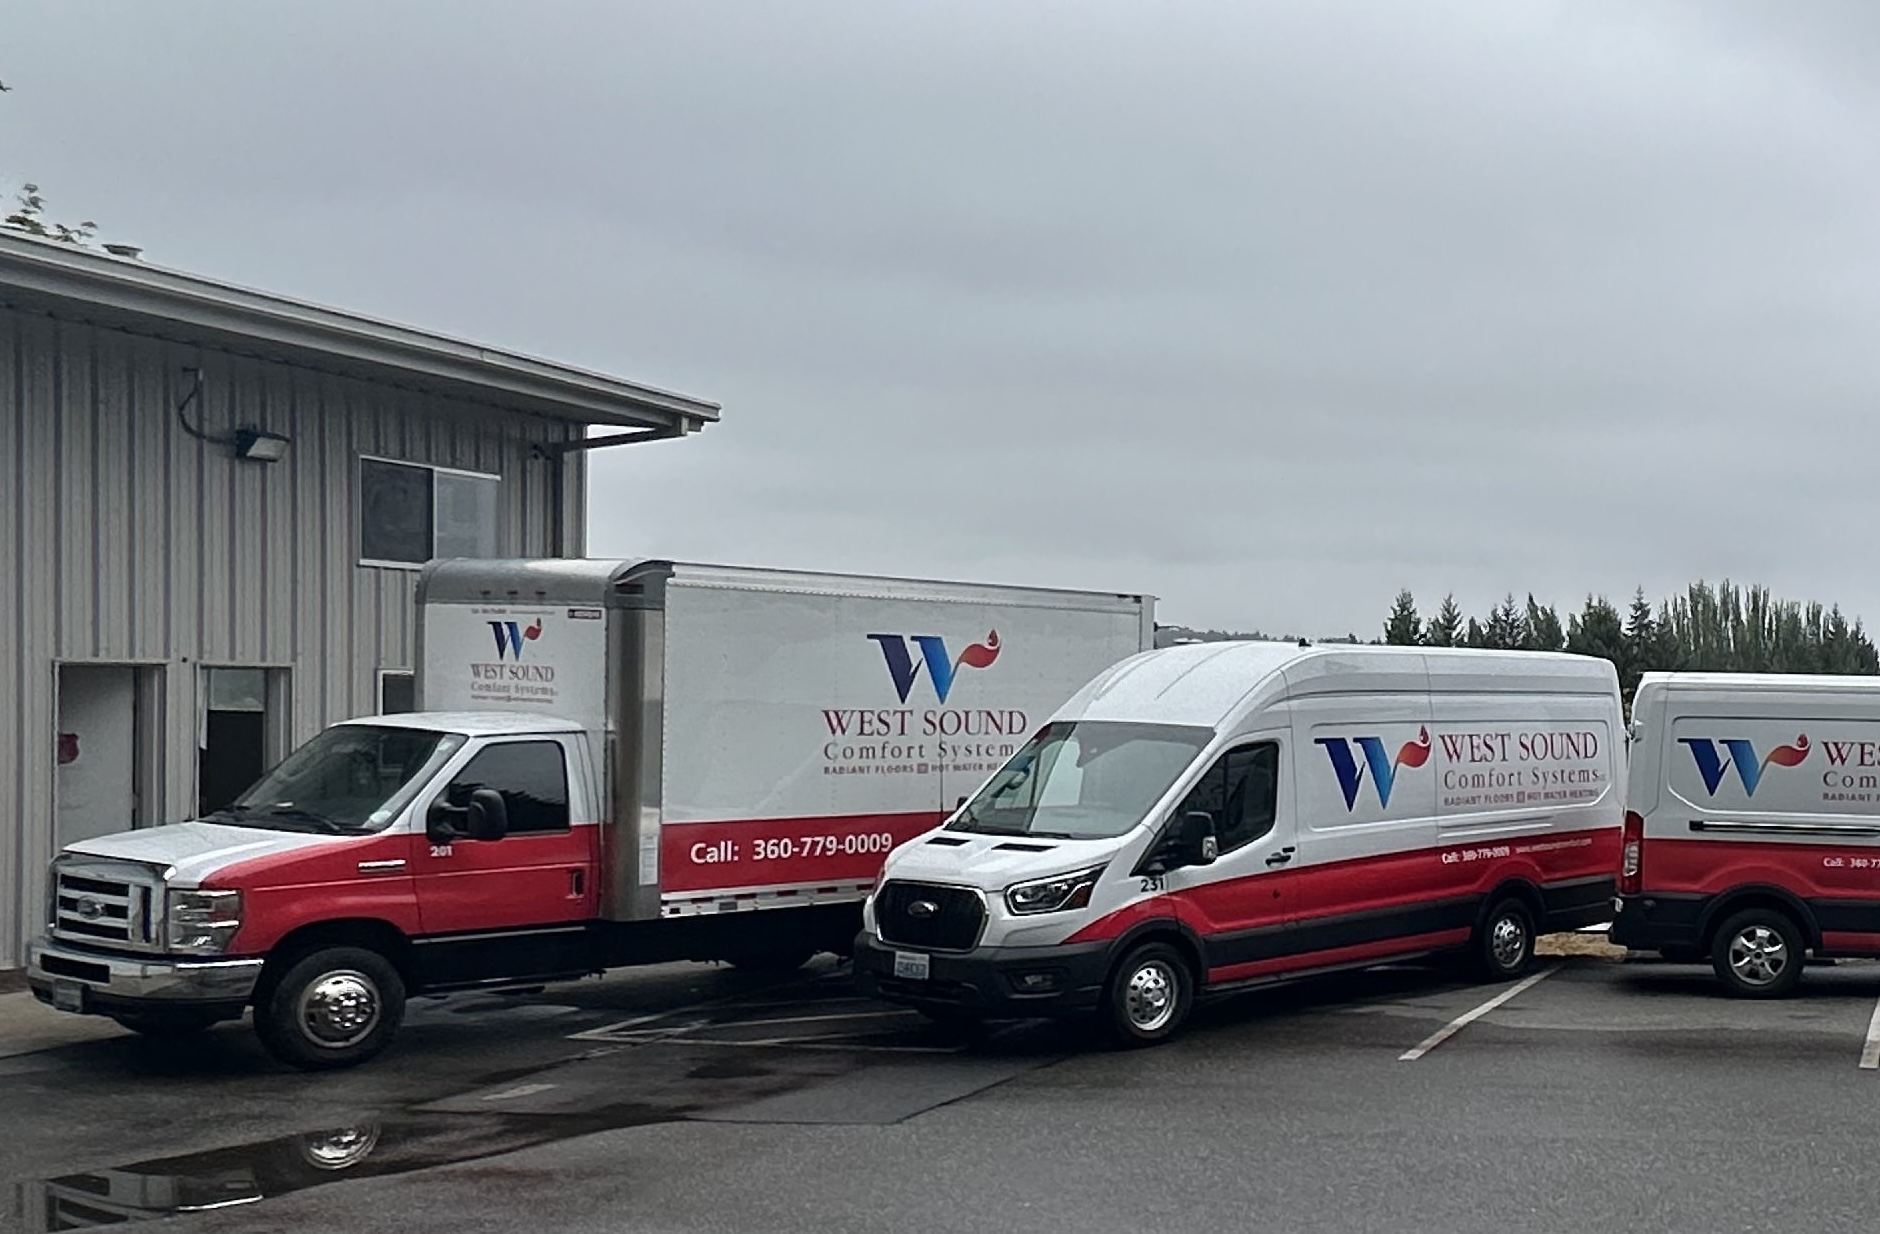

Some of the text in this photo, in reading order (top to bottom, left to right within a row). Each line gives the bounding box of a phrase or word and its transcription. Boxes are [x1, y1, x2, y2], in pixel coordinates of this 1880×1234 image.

[470, 664, 555, 682] WEST SOUND
[821, 709, 1027, 737] WEST SOUND
[824, 741, 1015, 763] Comfort System
[1439, 731, 1598, 764] WEST SOUND
[824, 765, 871, 775] RADIANT
[953, 762, 983, 772] WATER
[1444, 767, 1600, 791] Comfort Systems
[1822, 793, 1871, 802] RADIANT
[430, 845, 452, 857] 201
[690, 833, 893, 863] Call: 360-779-0009
[1140, 878, 1164, 892] 231
